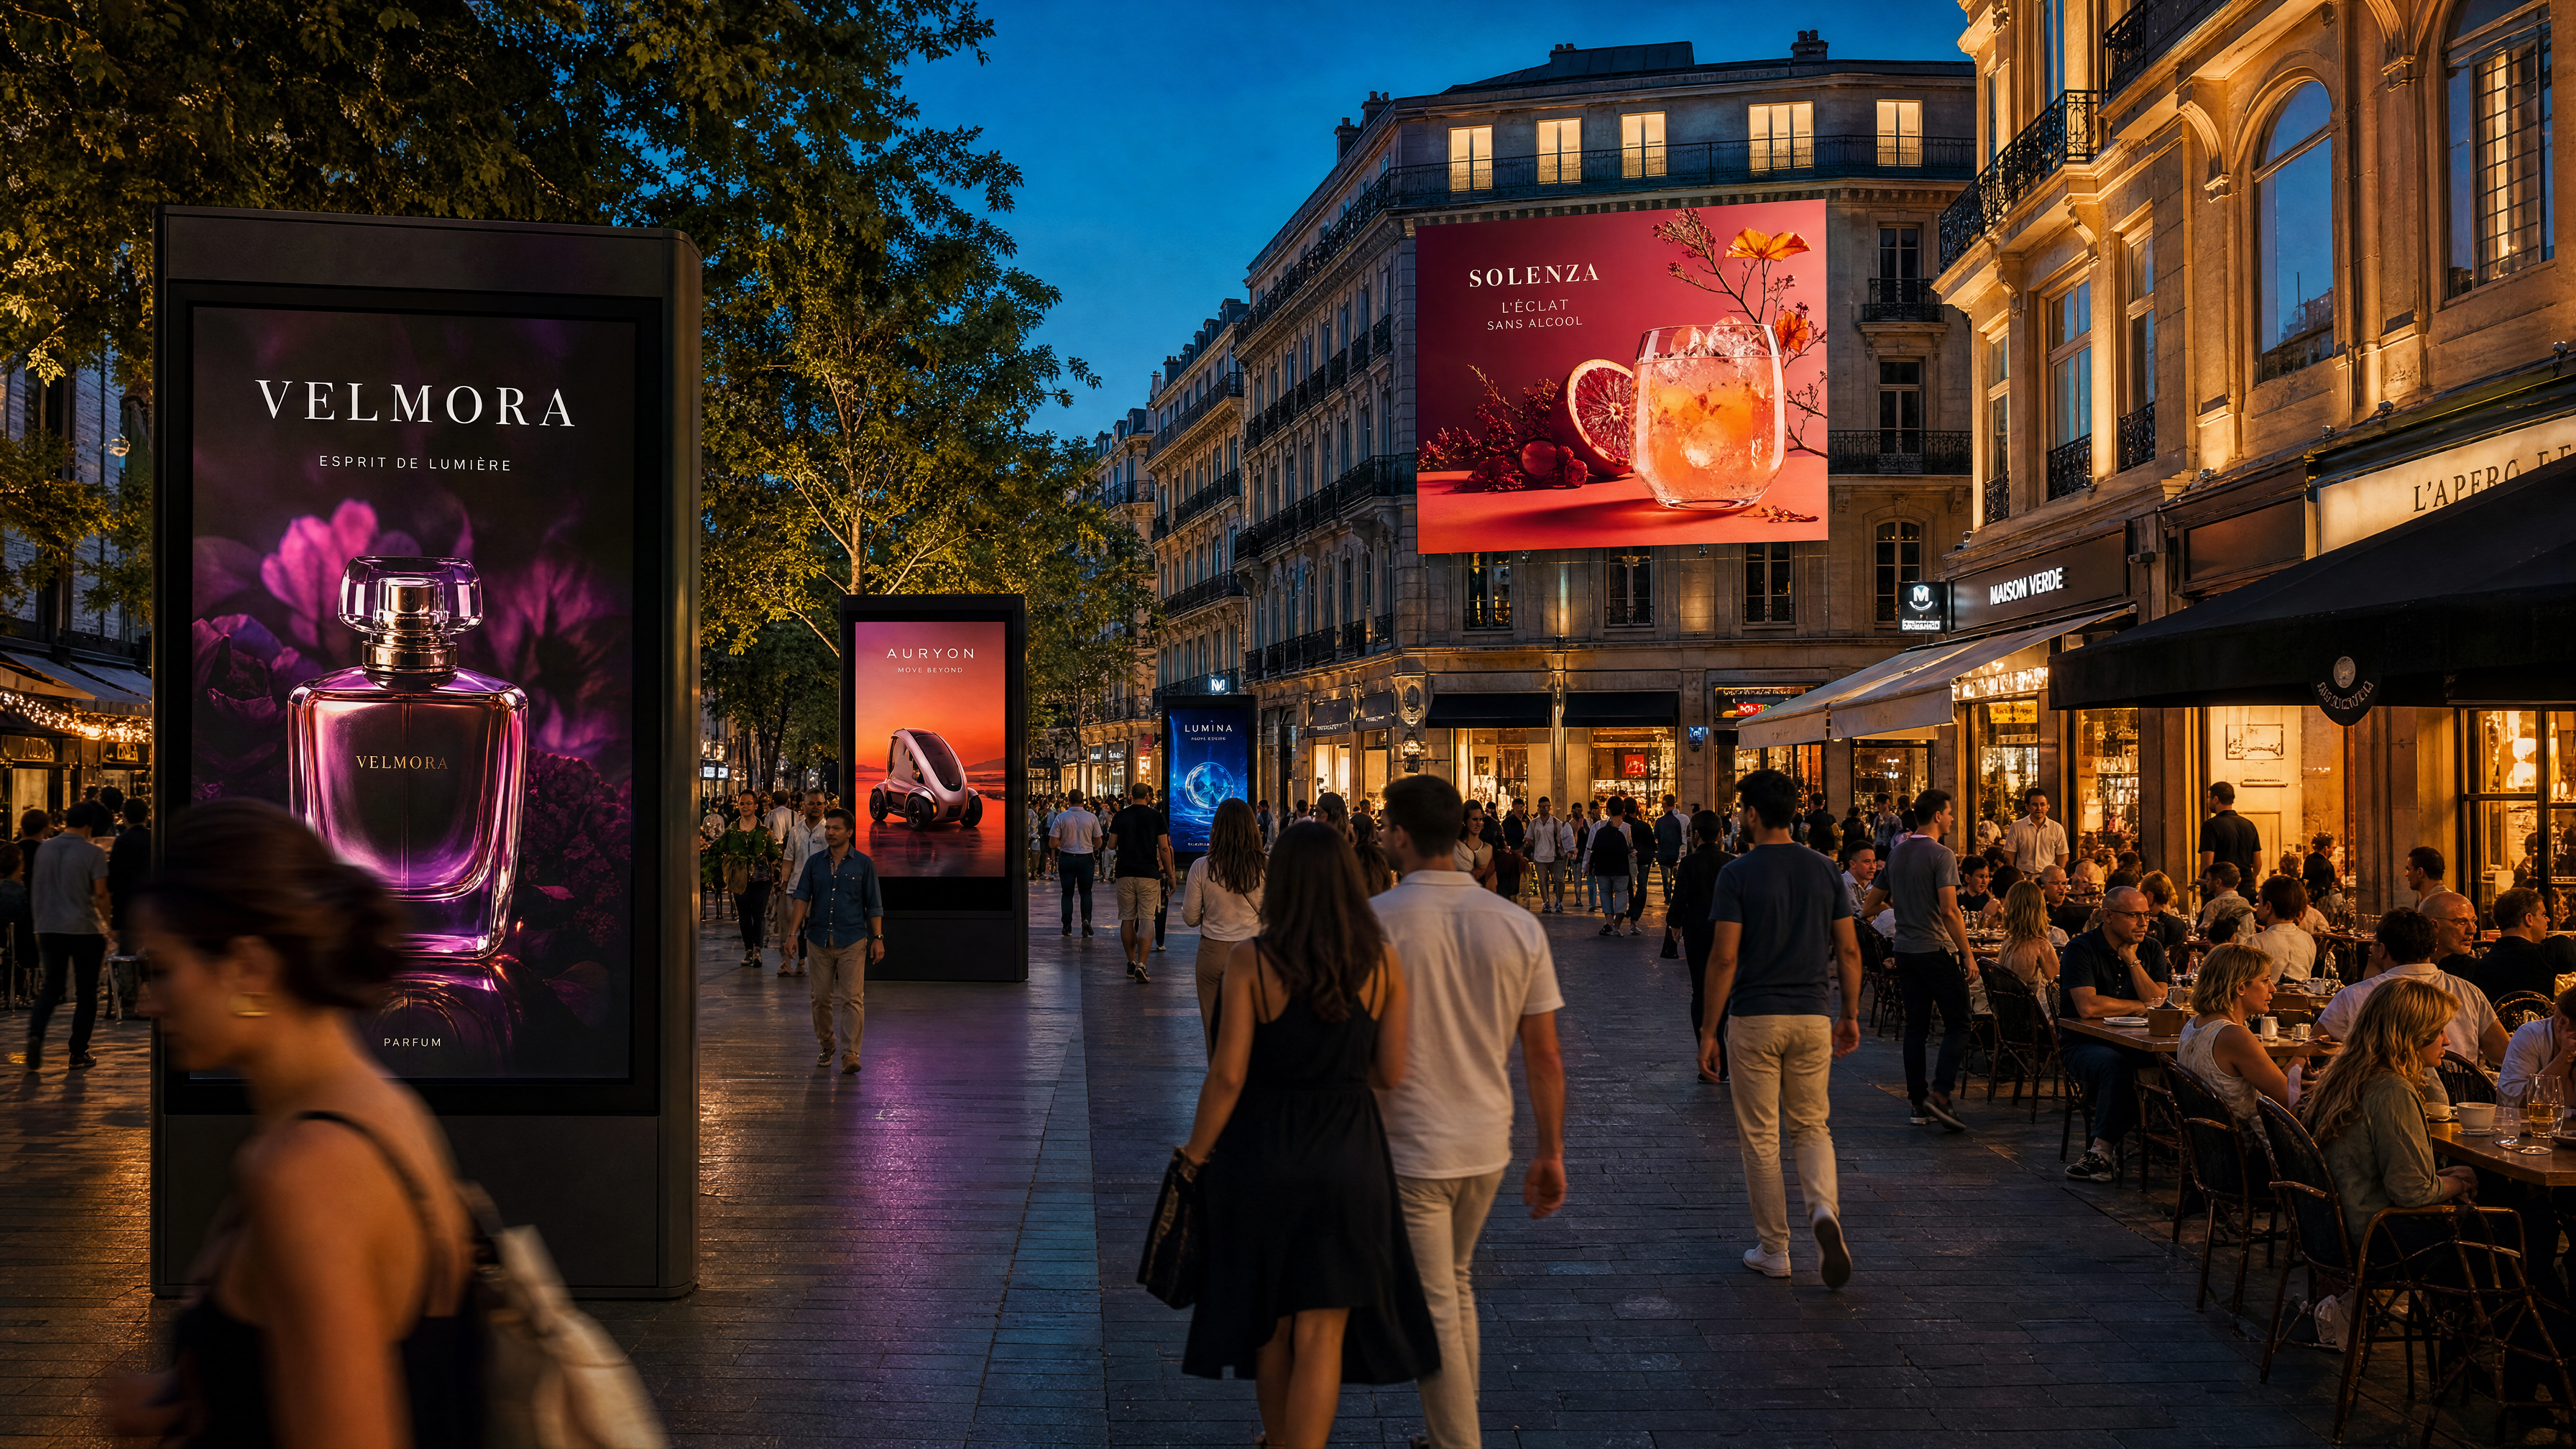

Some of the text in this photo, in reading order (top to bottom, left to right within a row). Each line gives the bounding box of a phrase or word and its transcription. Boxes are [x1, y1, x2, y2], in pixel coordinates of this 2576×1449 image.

[1468, 262, 1600, 288] SOLENZA
[1501, 298, 1569, 314] L'ÉCLAT
[1486, 315, 1583, 331] SANS ALCOOL
[254, 379, 576, 428] VELMORA
[319, 454, 511, 472] ESPRIT DE LUMIÈRE
[1913, 585, 1930, 602] M
[1989, 566, 2064, 606] MAISON VERDE
[886, 648, 975, 659] AURYON
[1184, 724, 1233, 732] LUMINA
[355, 755, 450, 770] VELMORA
[383, 1037, 441, 1048] PARFUM
